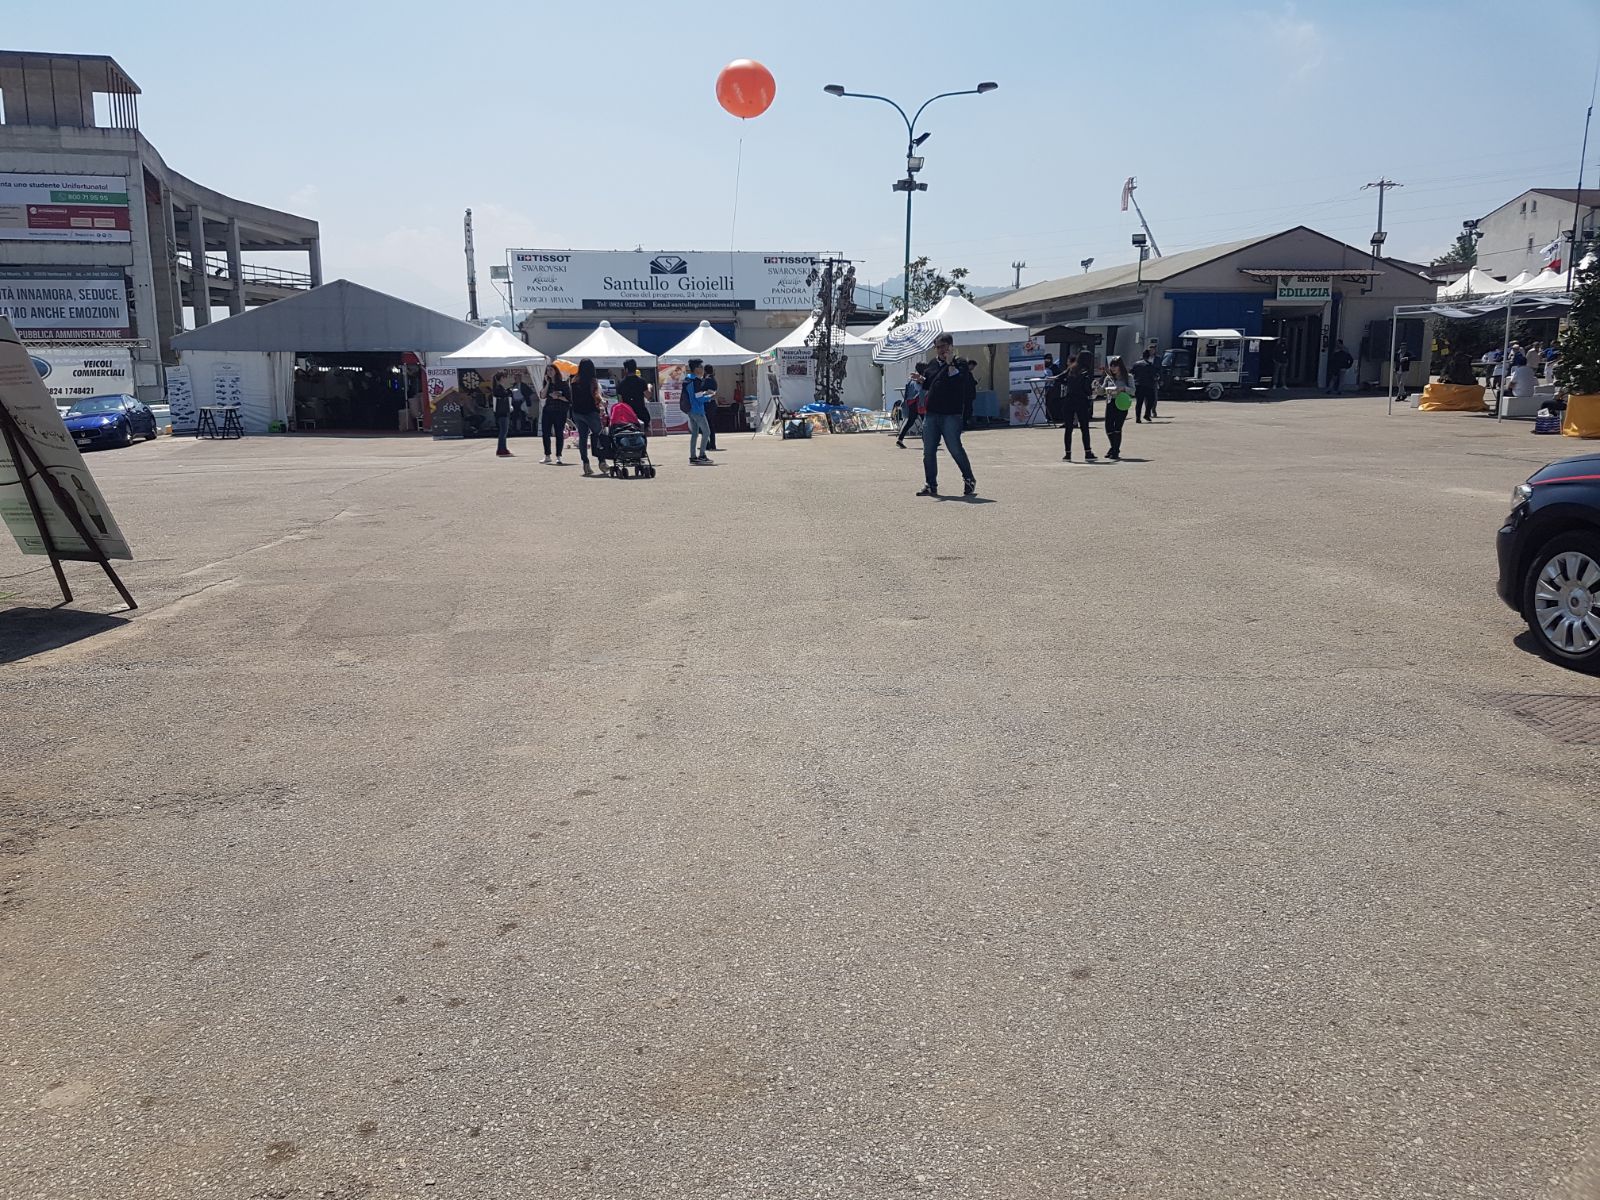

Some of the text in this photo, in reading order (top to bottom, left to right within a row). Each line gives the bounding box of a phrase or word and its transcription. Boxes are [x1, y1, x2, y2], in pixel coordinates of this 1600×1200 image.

[603, 276, 734, 291] Santullo Gioielli
[1297, 275, 1330, 283] SETTORE
[17, 288, 76, 302] INNAMORA,
[79, 288, 122, 301] SEDUCE.
[1278, 287, 1330, 298] EDILIZIA
[31, 306, 65, 318] ANCHE
[69, 306, 120, 318] EMOZIONI
[18, 330, 121, 339] PUBBLICA AMMINISTRAZIONE
[83, 360, 112, 368] VEICOLI
[72, 369, 125, 377] COMMERCIALI
[65, 387, 94, 395] 1748421
